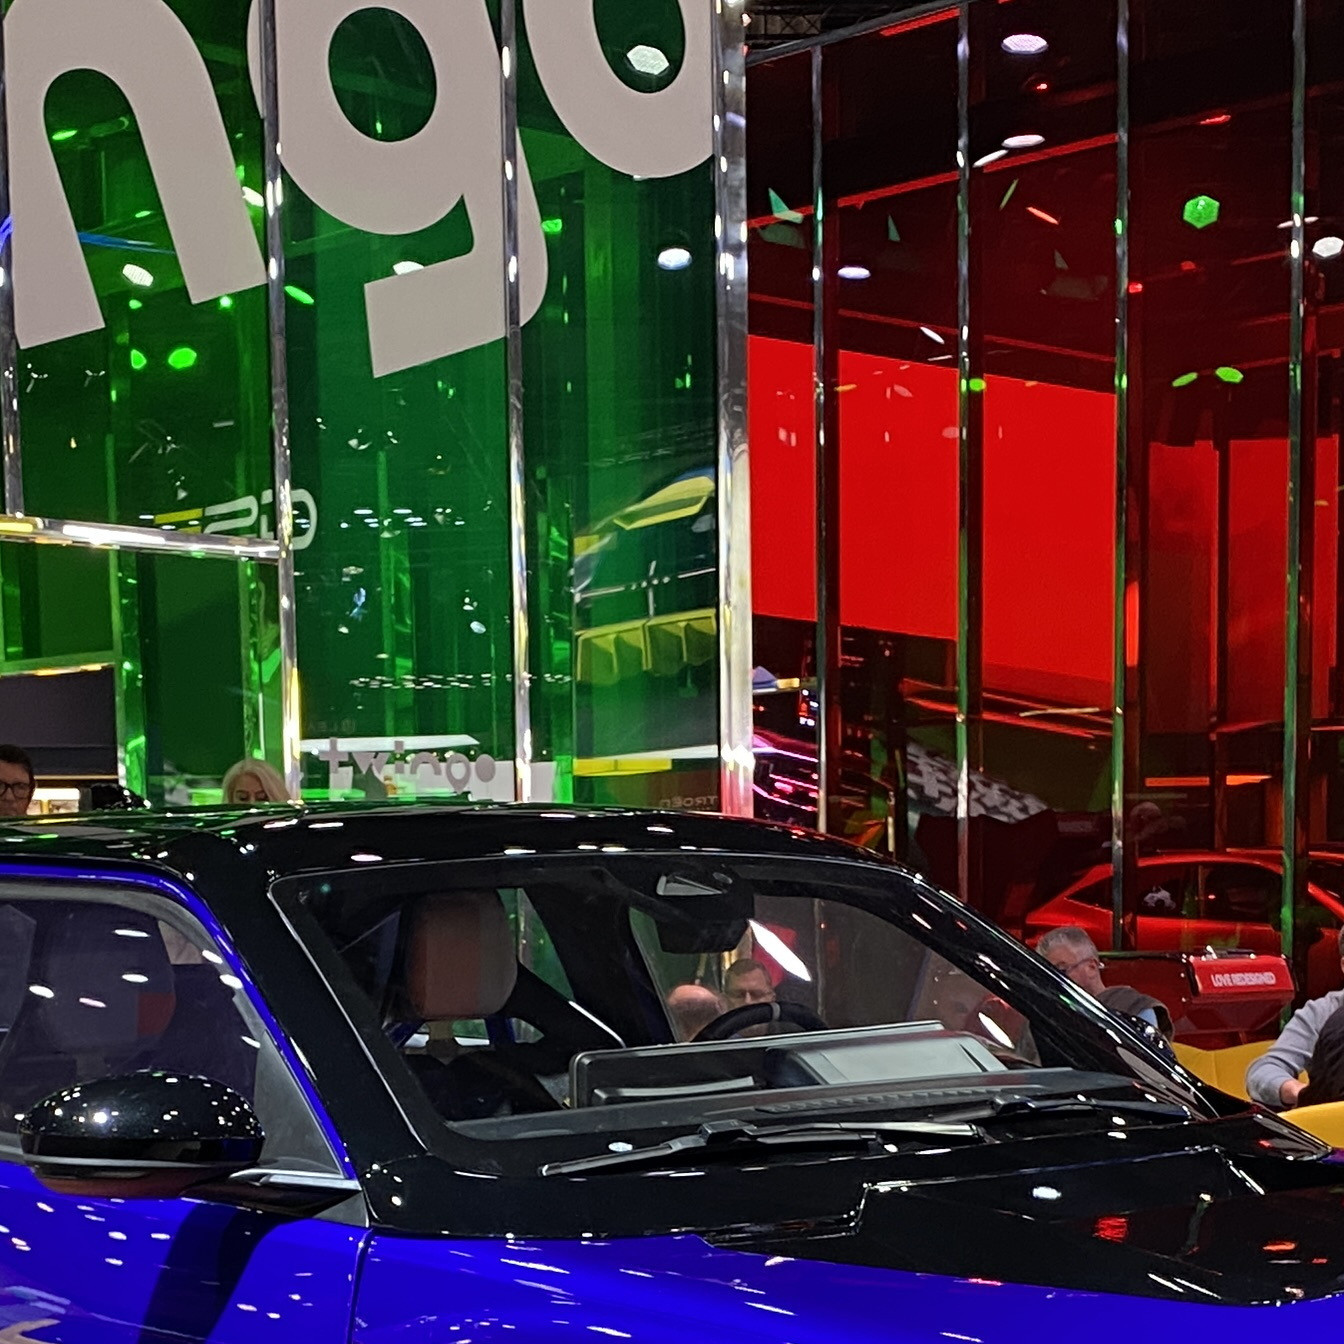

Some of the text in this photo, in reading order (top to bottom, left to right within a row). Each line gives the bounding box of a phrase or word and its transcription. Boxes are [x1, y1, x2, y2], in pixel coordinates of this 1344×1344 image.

[318, 737, 496, 794] twingo
[1211, 971, 1276, 987] LOVE REDESIGNED
